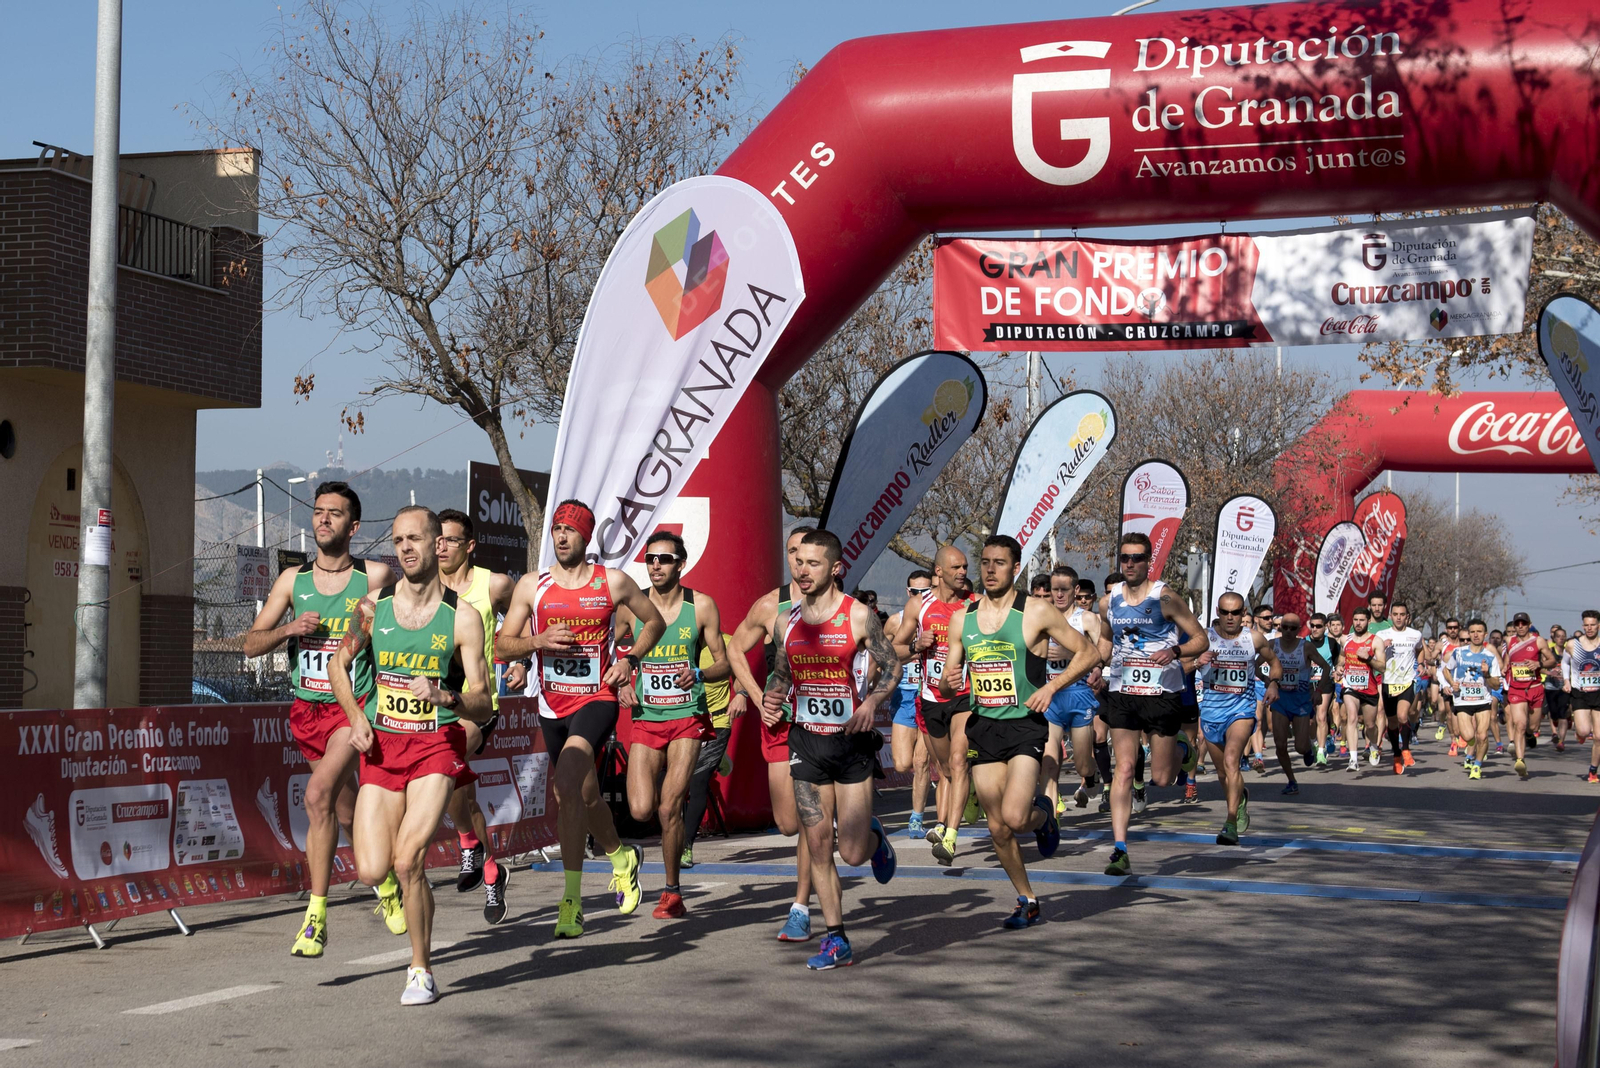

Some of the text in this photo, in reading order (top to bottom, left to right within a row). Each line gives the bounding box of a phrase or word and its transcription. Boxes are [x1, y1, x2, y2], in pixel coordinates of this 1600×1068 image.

[1132, 25, 1403, 79] Diputación
[1132, 75, 1403, 133] de Granada
[1134, 147, 1406, 179] Avanzamos junt@s
[1392, 238, 1457, 254] Diputación
[979, 247, 1228, 281] GRAN PREMIO
[1392, 251, 1457, 265] de Granada
[1481, 277, 1491, 295] SIN
[980, 286, 1167, 317] DE FONDO
[1449, 311, 1503, 320] MERCAGRANADA
[996, 323, 1097, 339] DIPUTACIÓN
[1125, 323, 1233, 339] CRUZCAMPO
[586, 283, 786, 563] CAGRANADA
[906, 410, 960, 476] Radler
[1056, 434, 1096, 487] Radler
[1142, 492, 1180, 505] Granada
[1150, 485, 1177, 496] Sabor
[1015, 484, 1060, 551] zcampo
[478, 532, 519, 548] La Inmobiliaria
[1221, 529, 1265, 544] Diputación
[1220, 540, 1264, 553] de Granada
[54, 562, 79, 578] 958 2
[1326, 576, 1341, 600] Mica
[1337, 546, 1355, 577] Motor
[379, 650, 440, 671] BIKILA
[792, 654, 840, 664] Clínicas
[410, 669, 440, 677] GRANADA
[553, 658, 591, 677] 625
[793, 668, 847, 680] Polisalud
[1213, 669, 1247, 682] 1109
[1132, 669, 1151, 684] 99
[1350, 675, 1366, 683] 669
[550, 682, 591, 695] Cruzcampo
[976, 678, 1013, 692] 3036
[1465, 687, 1481, 695] 538
[386, 694, 435, 715] 3030
[649, 695, 684, 705] Cruzcampo
[807, 697, 845, 717] 630
[978, 696, 1009, 706] Cruzcampo
[382, 715, 427, 732] Cruzcampo
[509, 709, 518, 730] de
[18, 720, 229, 755] XXXI Gran Premio de Fondo
[253, 718, 282, 744] XXXI
[493, 734, 531, 750] Cruzcampo
[61, 756, 128, 782] Diputación
[143, 752, 201, 774] Cruzcampo
[116, 803, 159, 819] Cruzcampo
